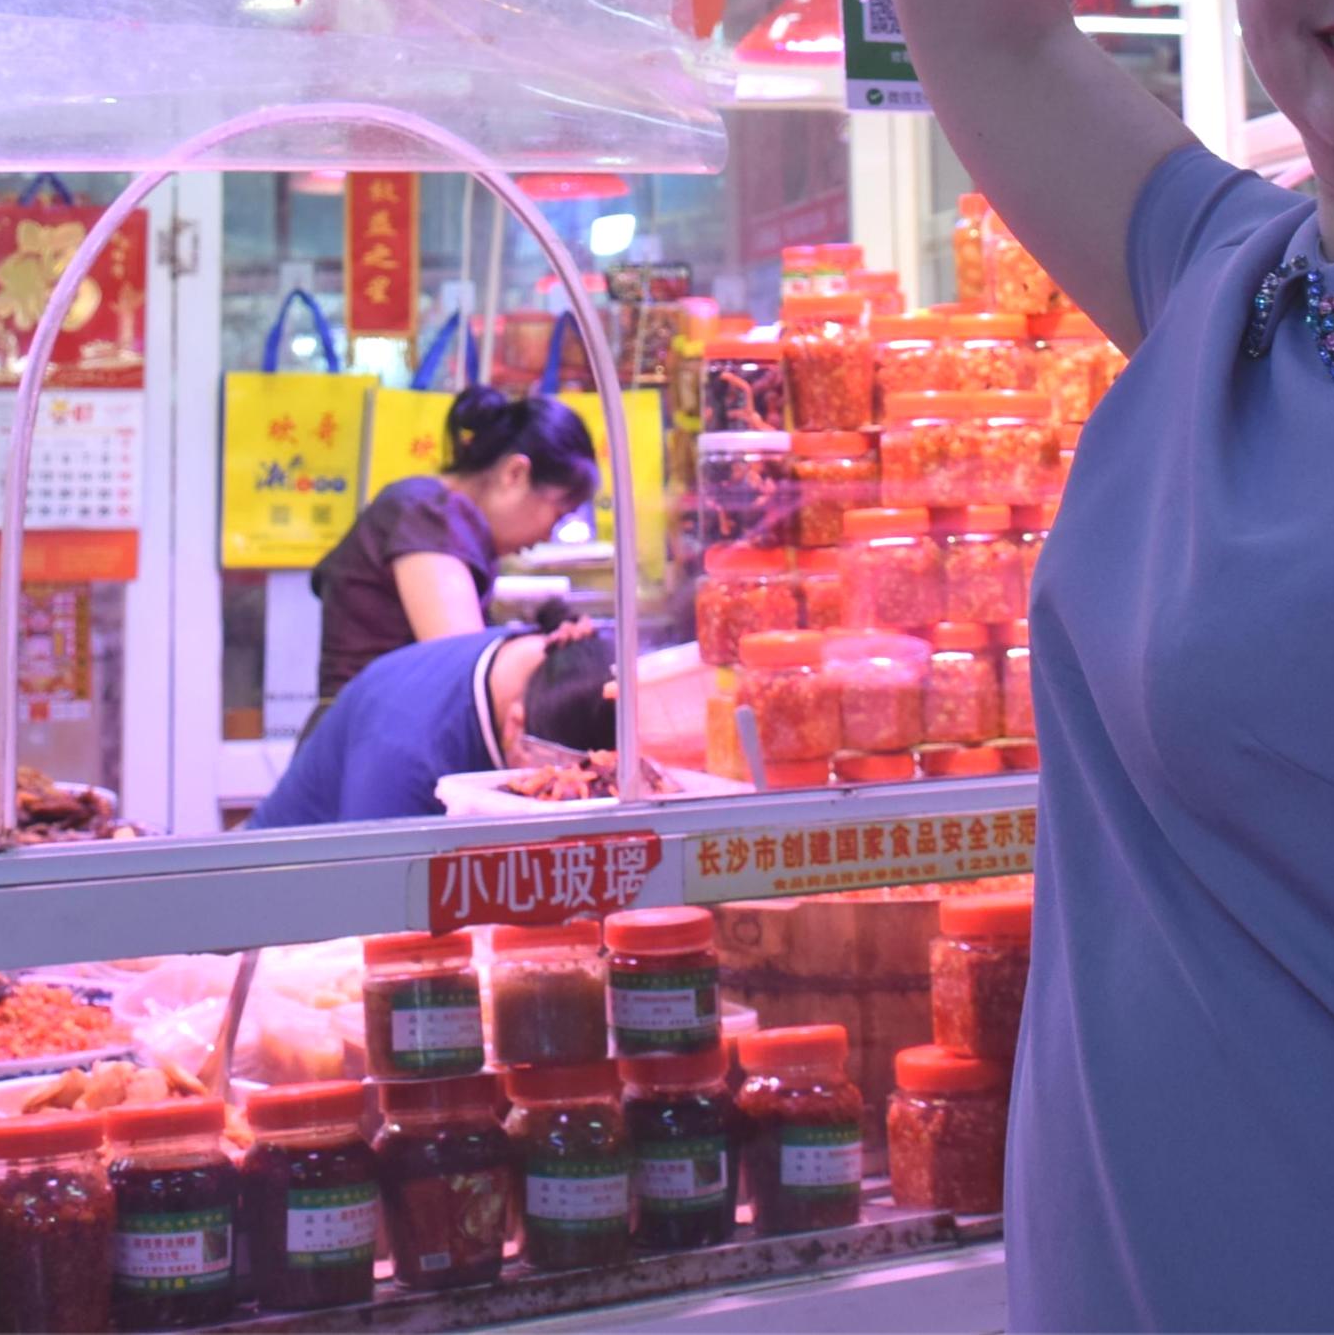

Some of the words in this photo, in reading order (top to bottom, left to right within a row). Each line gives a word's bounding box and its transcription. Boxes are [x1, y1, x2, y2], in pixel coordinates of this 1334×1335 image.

[697, 811, 1036, 877] 长沙市创建国家食品安全示范
[955, 853, 1028, 873] 12315
[440, 840, 651, 919] 小心玻璃
